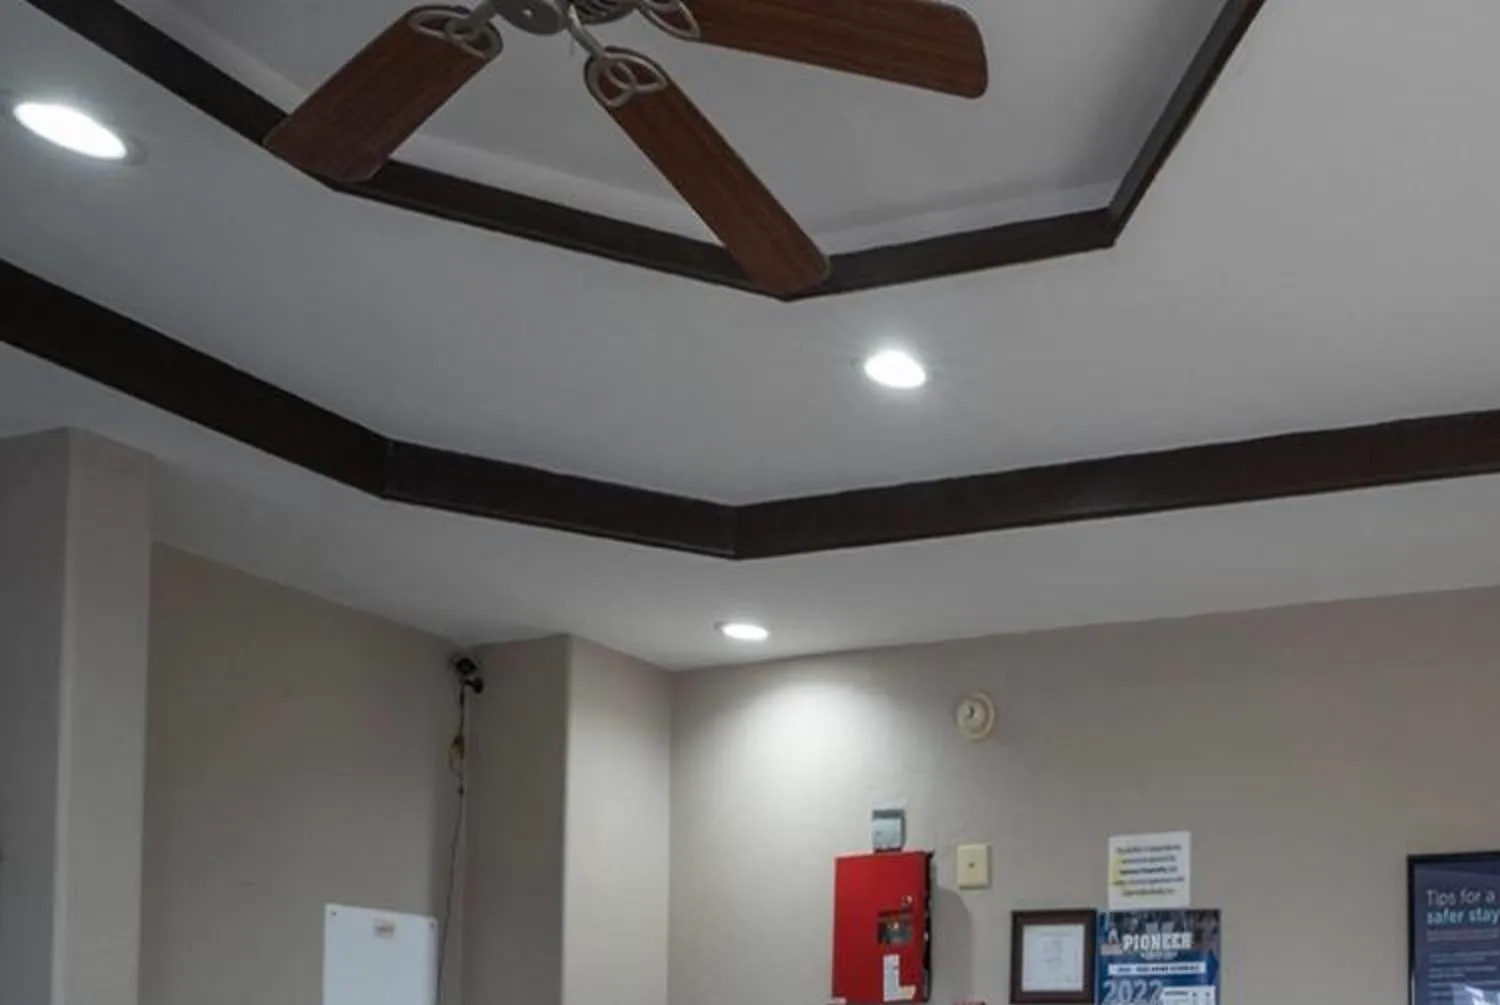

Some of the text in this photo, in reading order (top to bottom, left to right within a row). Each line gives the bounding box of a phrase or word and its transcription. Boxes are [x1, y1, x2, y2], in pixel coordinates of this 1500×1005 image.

[1426, 887, 1496, 907] Tips for a
[1426, 906, 1500, 925] safer stay
[1122, 931, 1192, 951] PIONEER
[1103, 978, 1164, 1005] 2022
